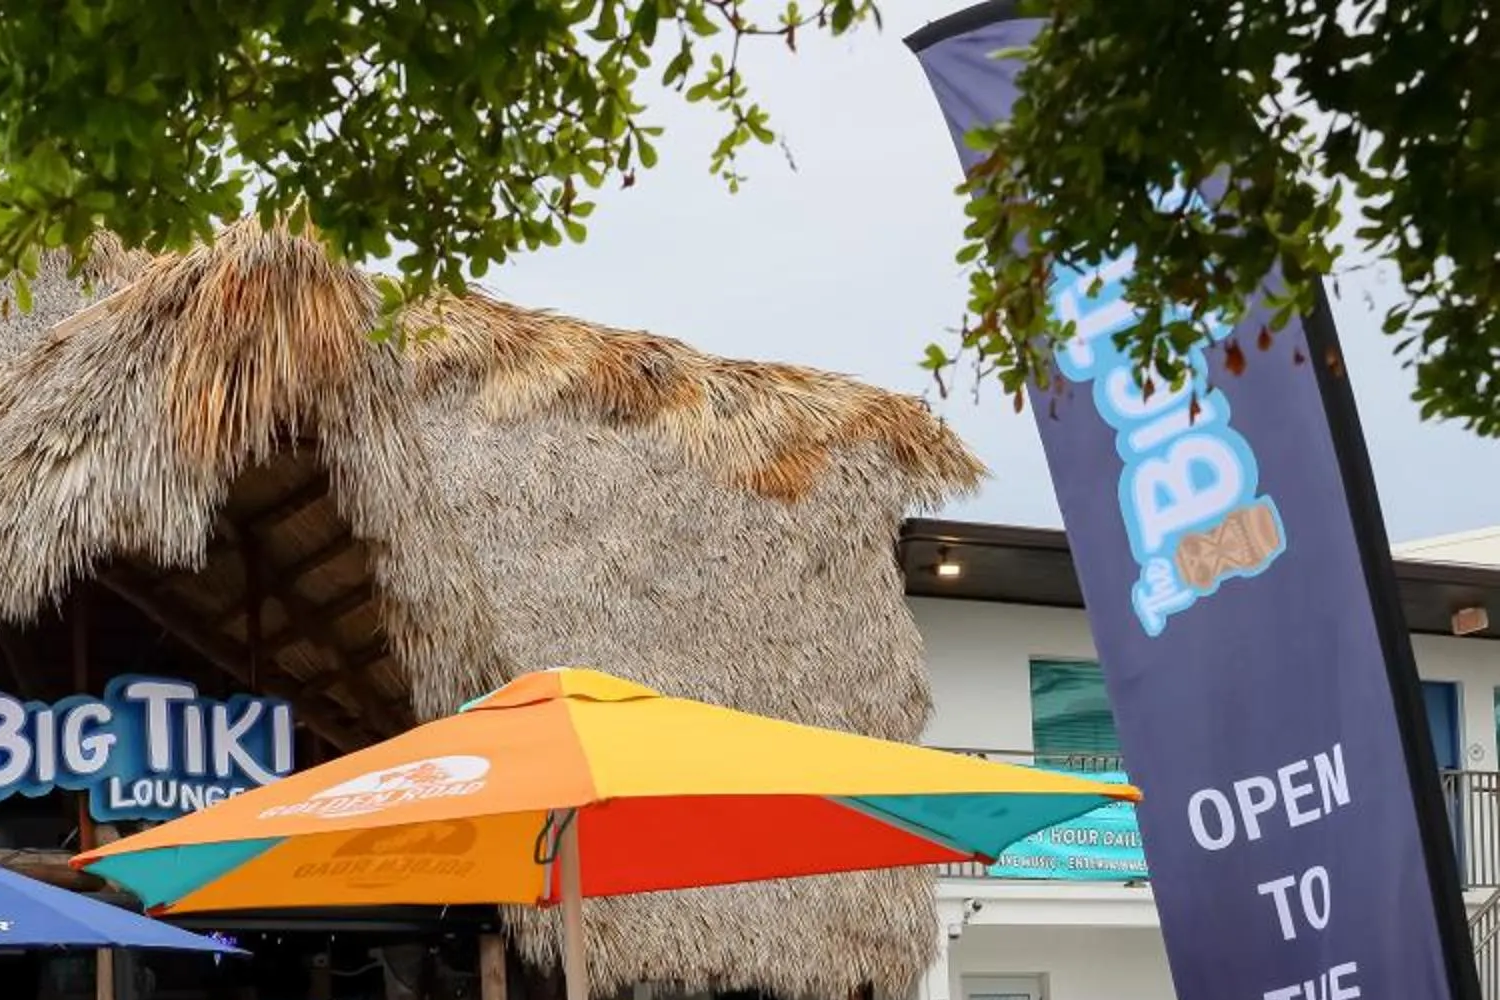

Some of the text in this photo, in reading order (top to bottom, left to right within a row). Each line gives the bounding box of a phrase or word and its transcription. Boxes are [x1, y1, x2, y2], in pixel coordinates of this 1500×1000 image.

[126, 682, 292, 785] TIKI
[1050, 829, 1099, 846] HOUR
[1102, 831, 1143, 848] DAIL
[1188, 743, 1351, 851] OPEN
[1258, 865, 1331, 940] TO
